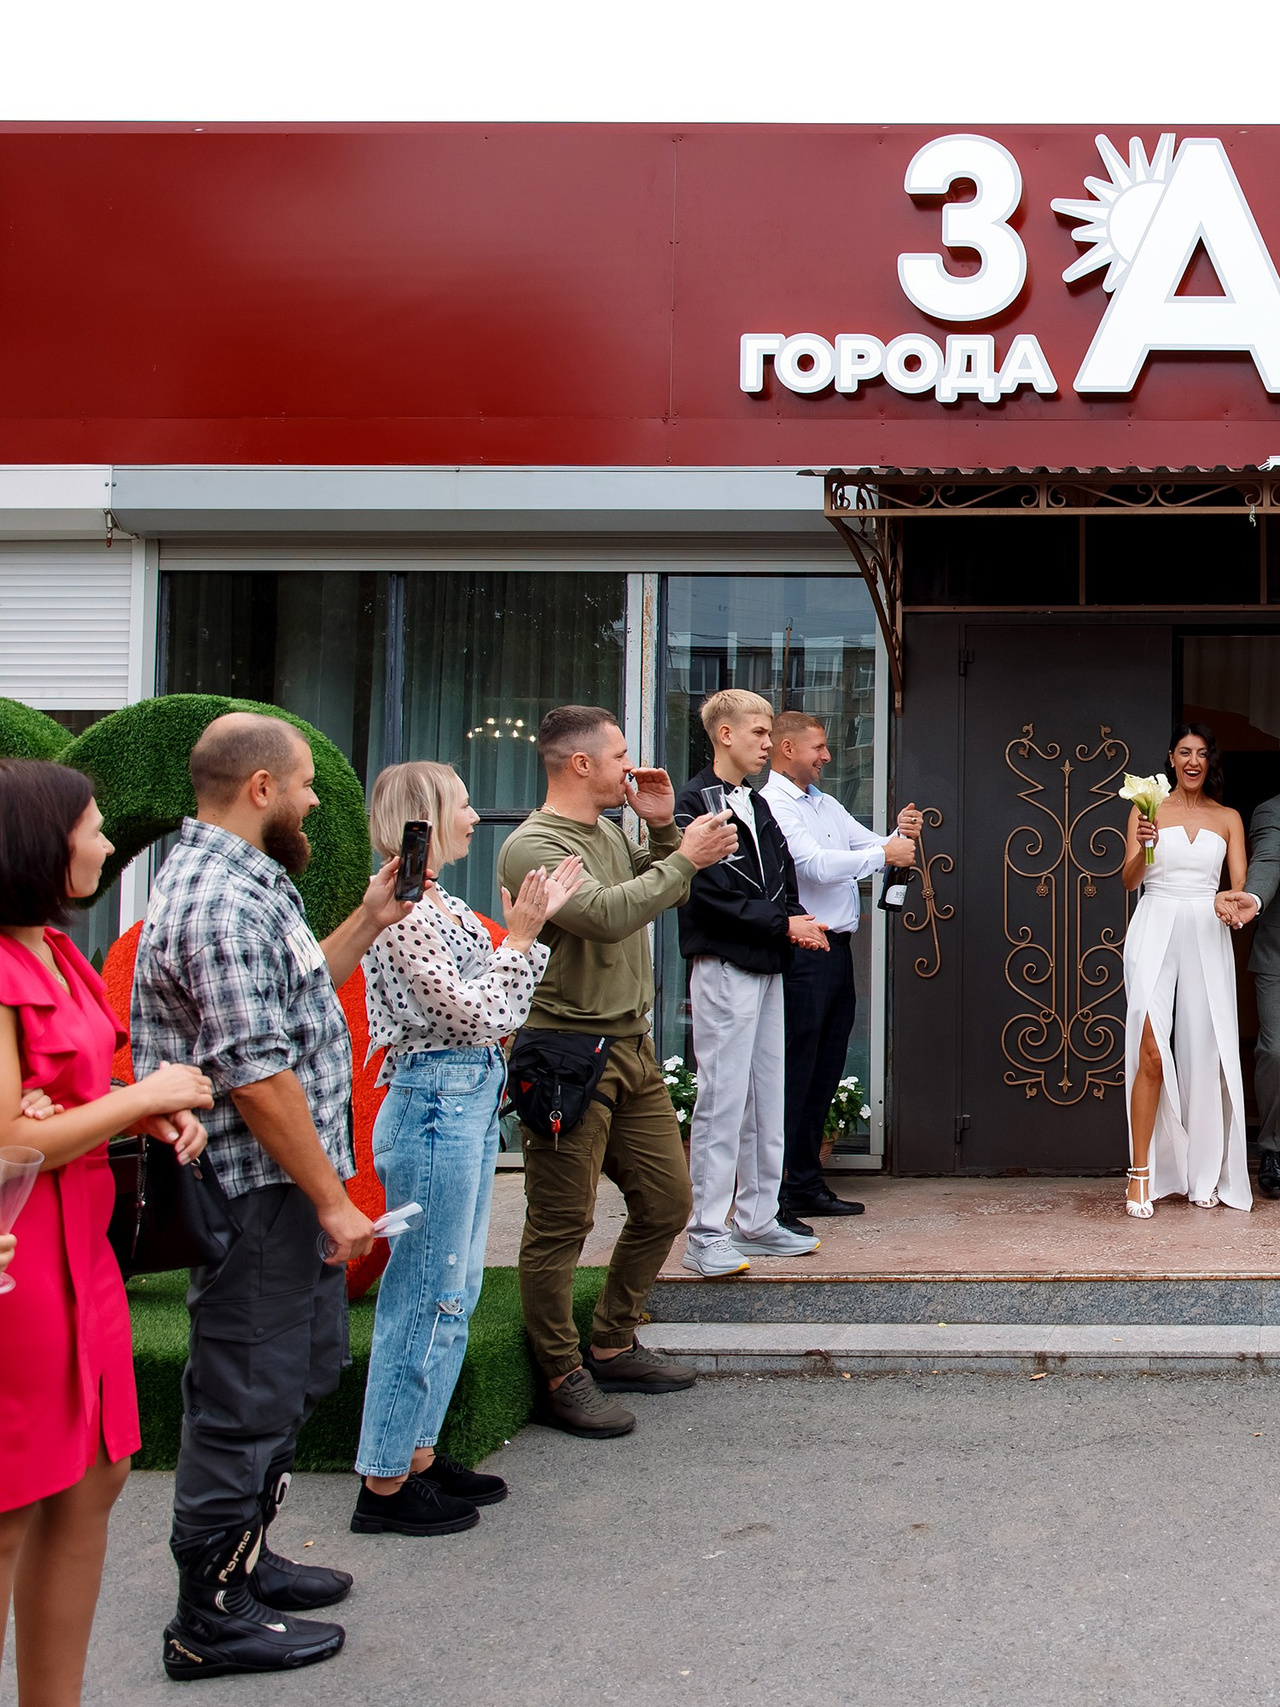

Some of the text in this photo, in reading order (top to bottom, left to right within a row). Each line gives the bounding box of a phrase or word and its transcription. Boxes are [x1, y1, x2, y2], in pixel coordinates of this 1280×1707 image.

[740, 333, 1058, 404] ГОРОДА
[218, 1530, 251, 1582] Forma
[169, 1638, 202, 1663] Forma
